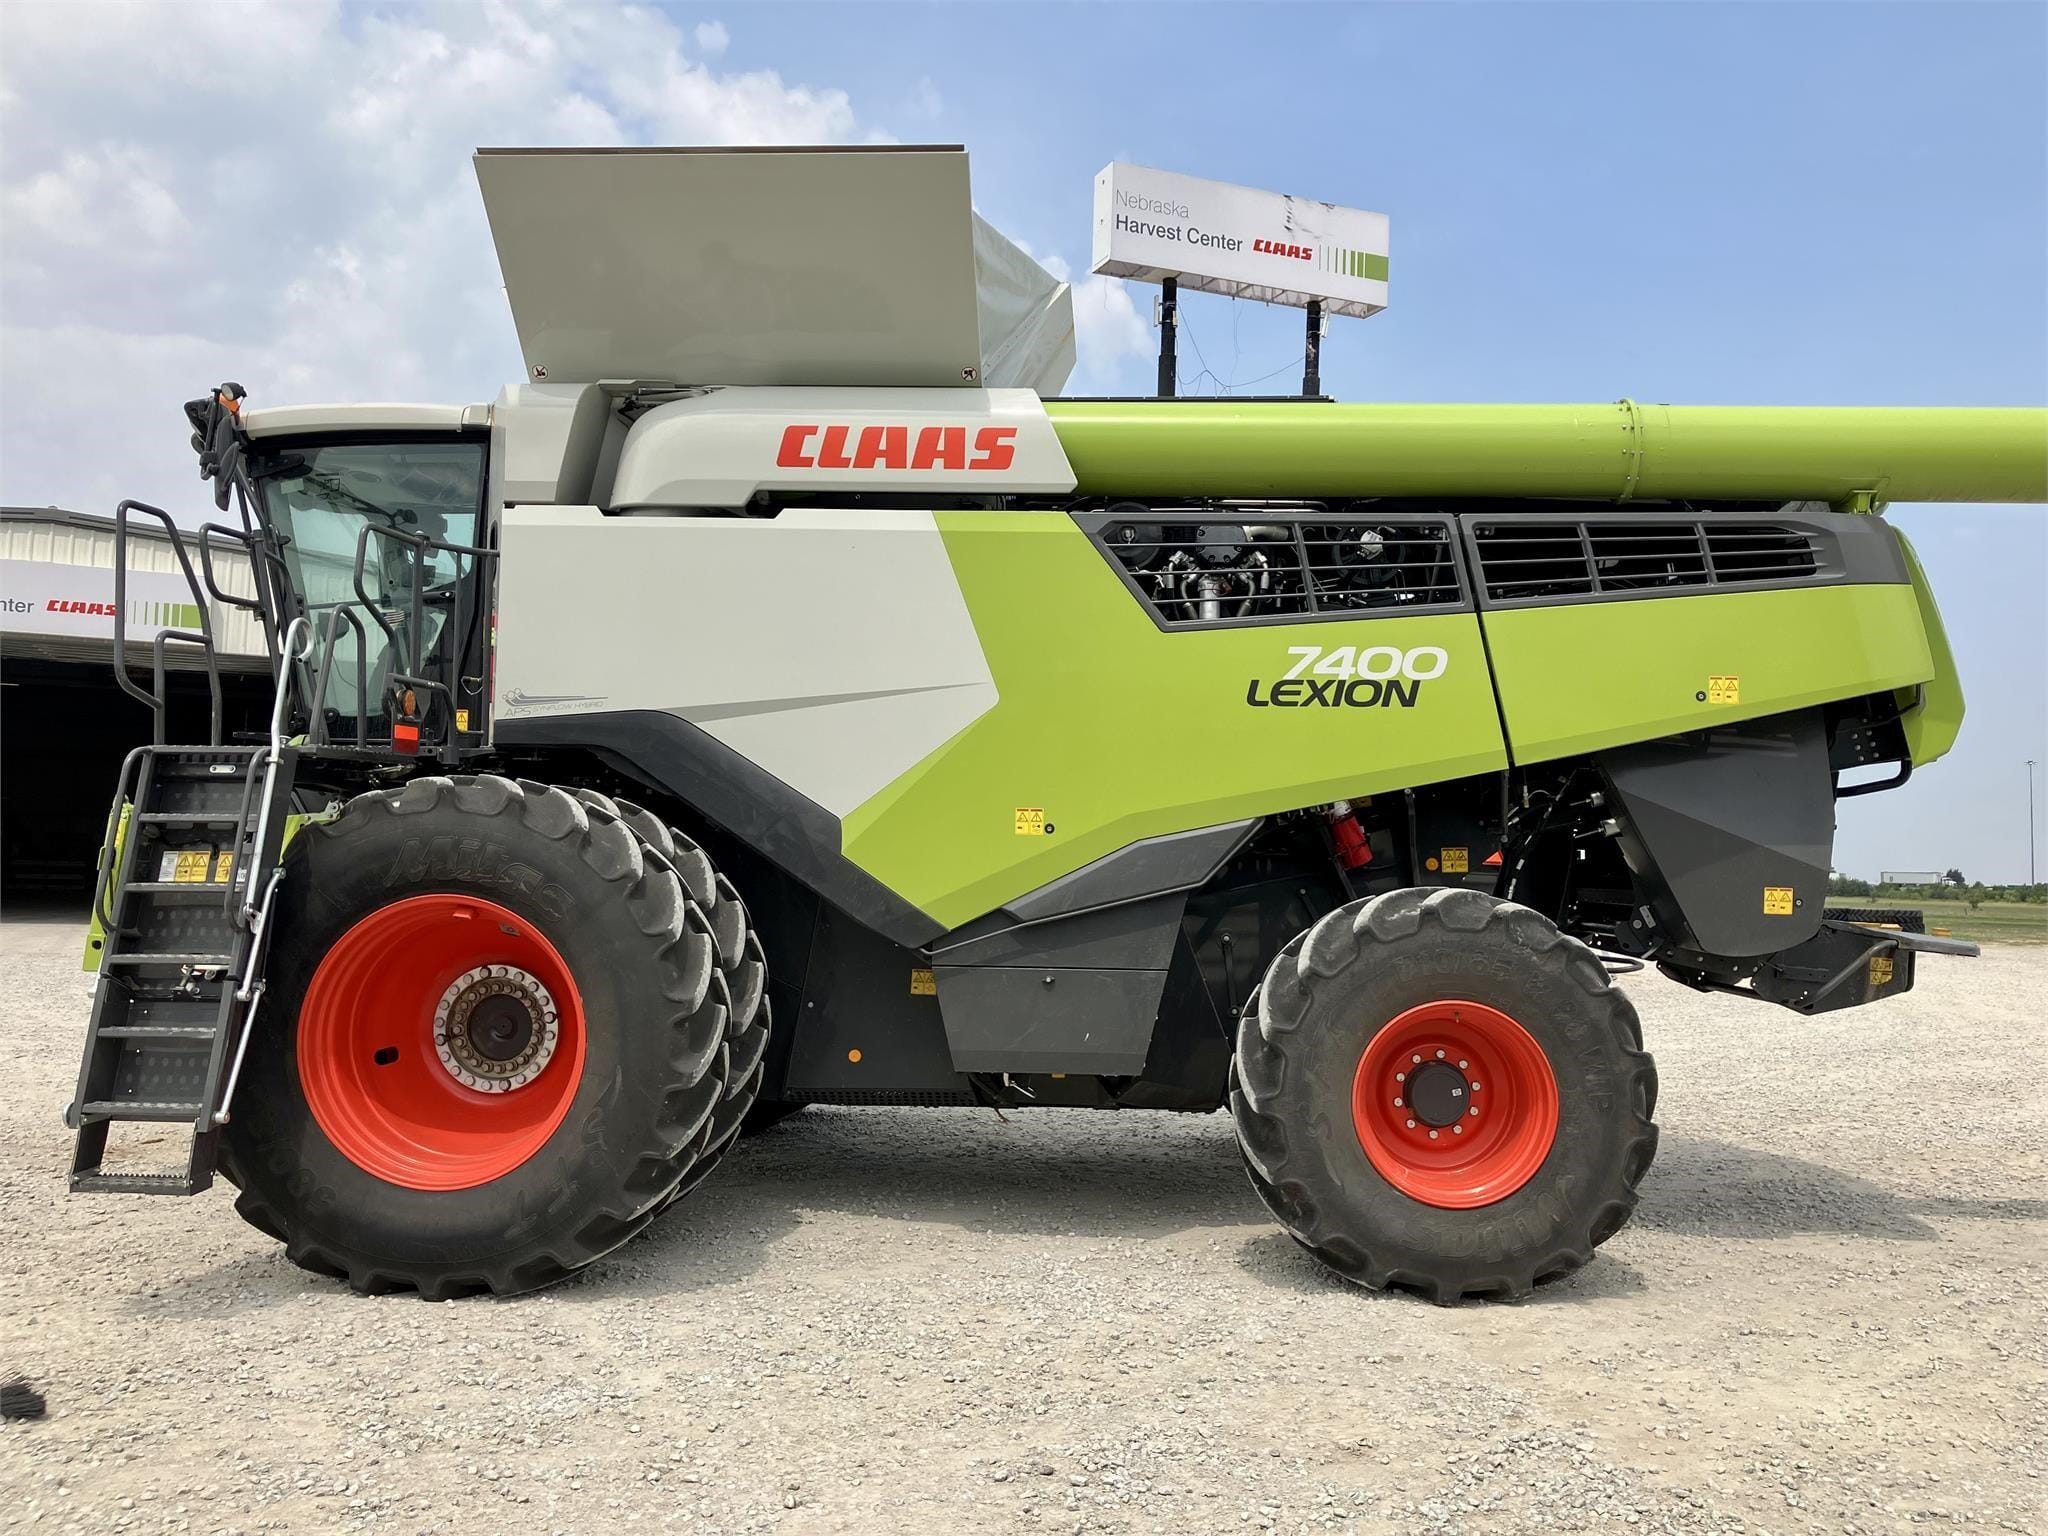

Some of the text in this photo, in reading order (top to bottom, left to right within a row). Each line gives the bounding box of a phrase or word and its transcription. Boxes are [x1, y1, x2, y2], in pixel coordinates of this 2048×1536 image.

[1115, 189, 1190, 219] Nebraska
[1115, 213, 1313, 261] Harvest Center CLAAS
[776, 425, 1018, 470] CLAAS
[46, 599, 116, 616] CLAAS
[1283, 646, 1448, 680] 7400
[1246, 679, 1421, 708] LEXION
[504, 706, 532, 717] APS
